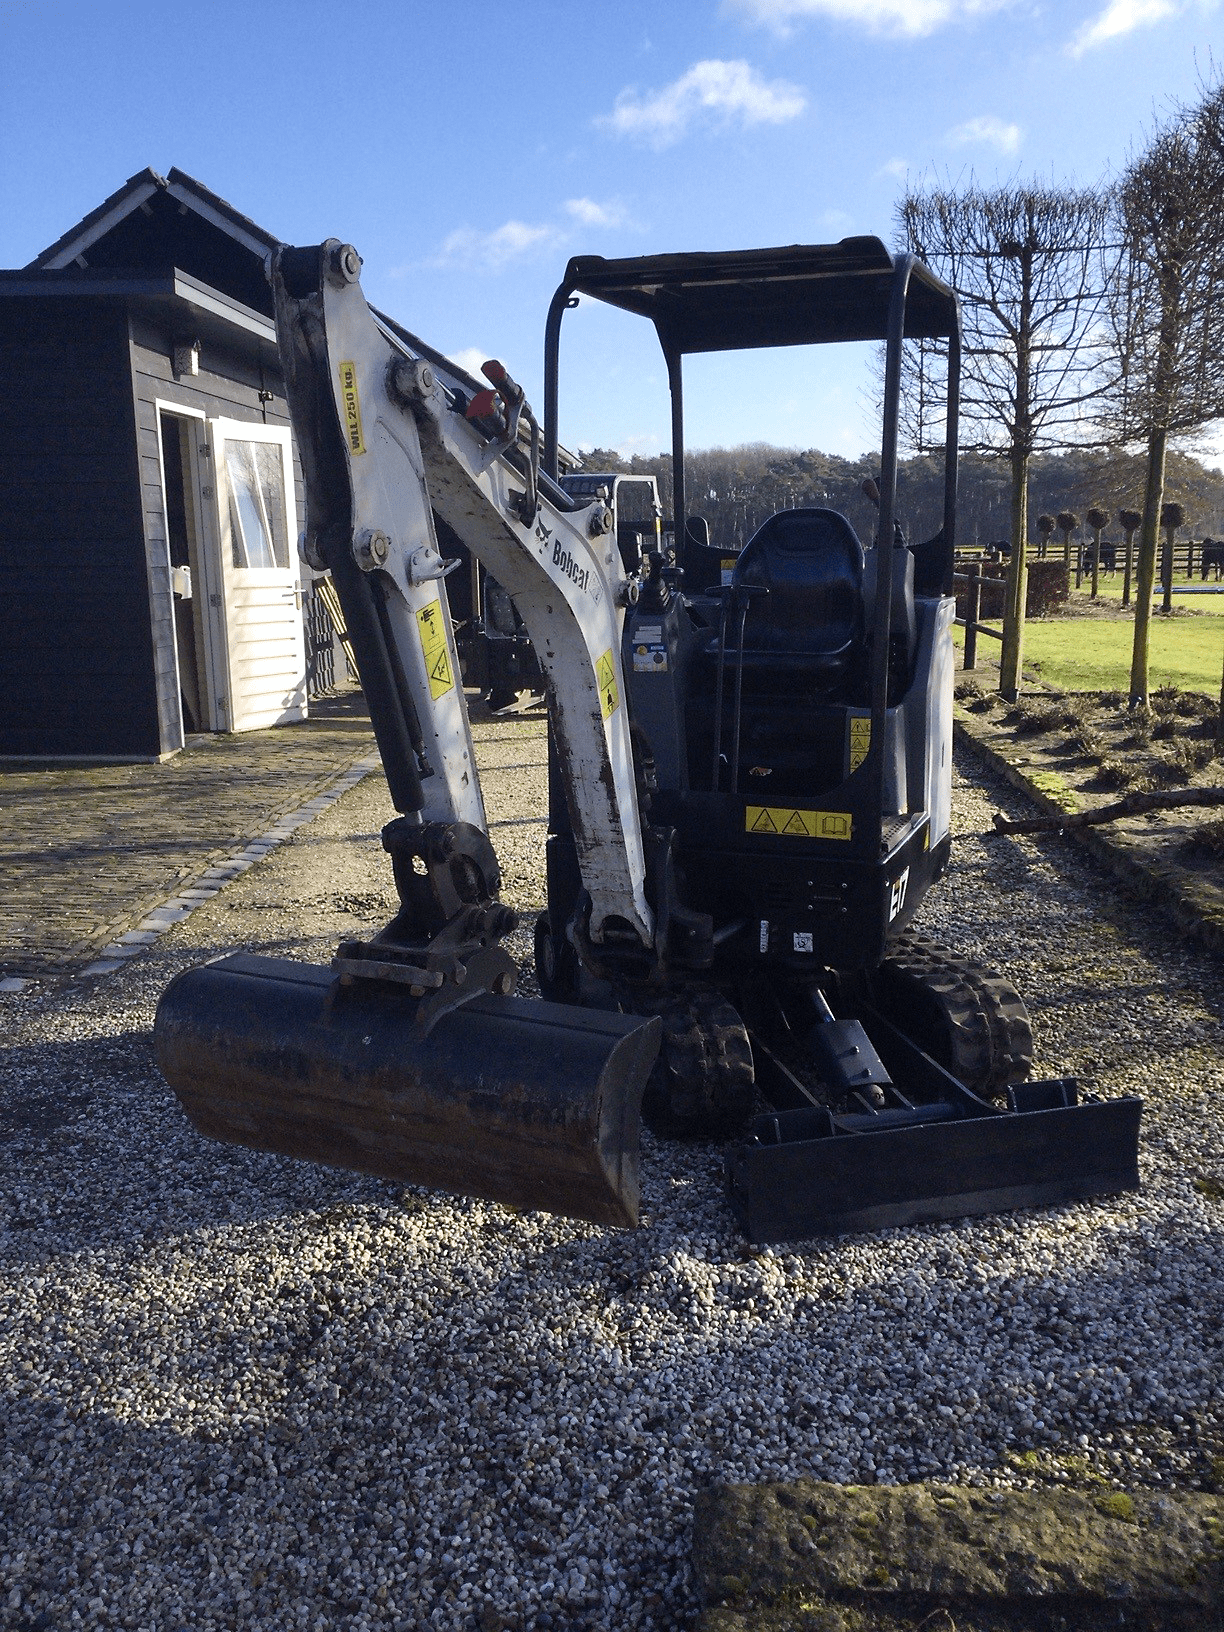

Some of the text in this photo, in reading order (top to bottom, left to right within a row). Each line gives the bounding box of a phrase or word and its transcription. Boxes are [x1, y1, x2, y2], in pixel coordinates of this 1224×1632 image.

[345, 392, 357, 419] 250
[350, 422, 360, 450] WLL
[552, 538, 590, 591] Bobcat
